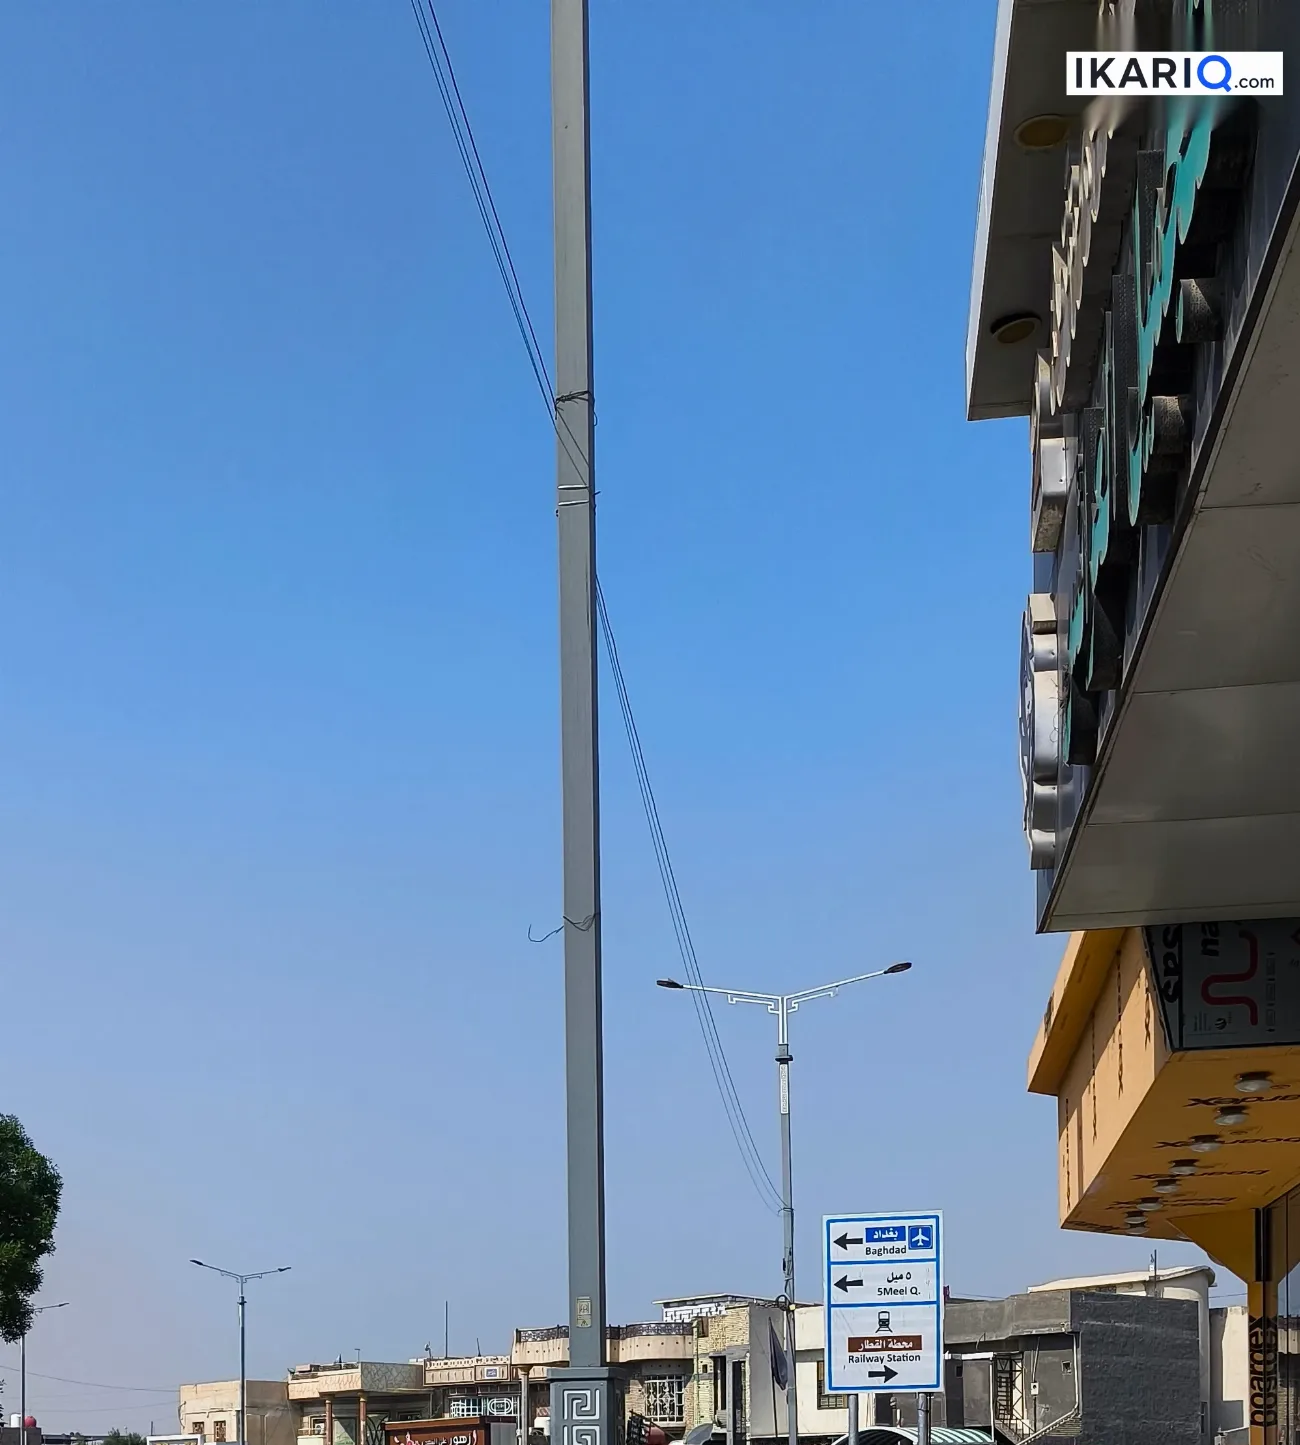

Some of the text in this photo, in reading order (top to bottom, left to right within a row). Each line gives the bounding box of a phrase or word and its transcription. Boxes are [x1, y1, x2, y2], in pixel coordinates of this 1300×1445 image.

[873, 1227, 899, 1240] بغداد
[865, 1247, 907, 1257] Baghdad
[886, 1271, 904, 1283] ميل
[877, 1285, 921, 1296] 5Meel Q.
[858, 1339, 913, 1351] محطة القطار
[848, 1352, 921, 1364] Railway Station
